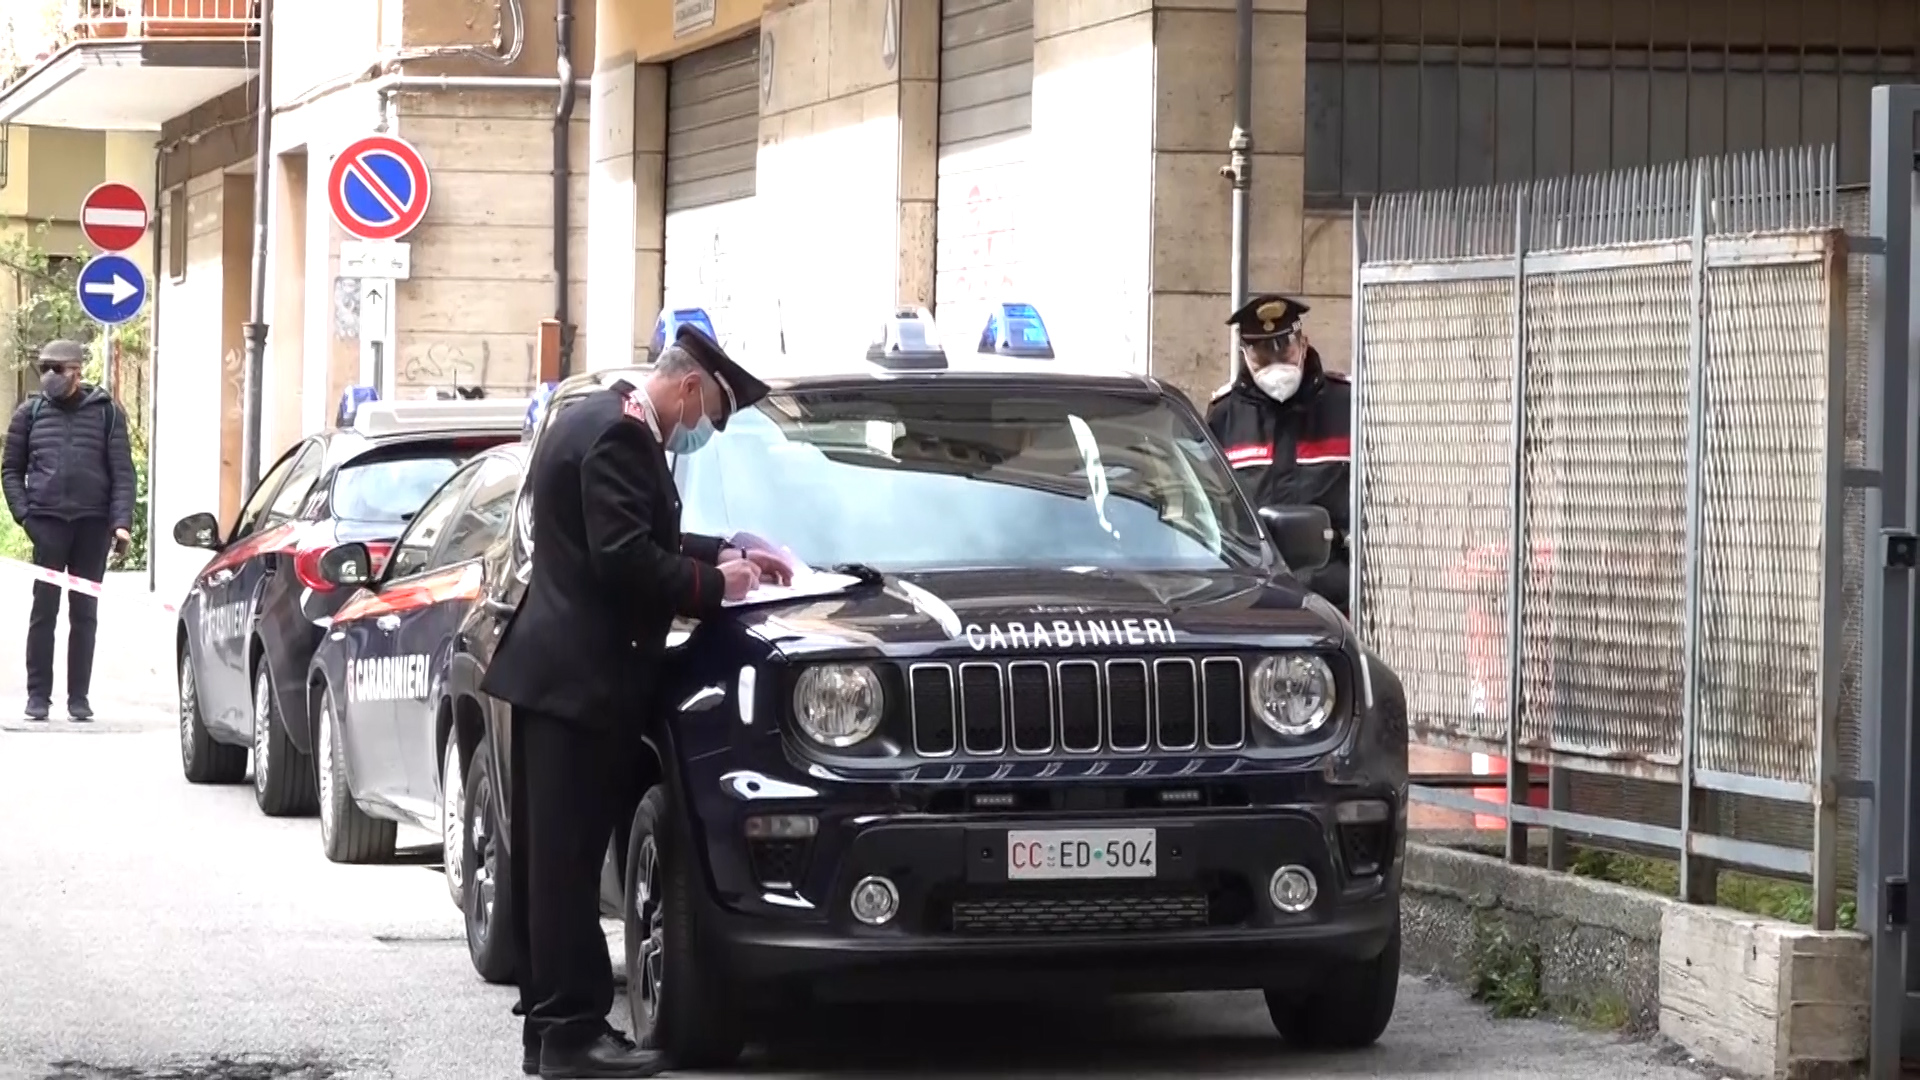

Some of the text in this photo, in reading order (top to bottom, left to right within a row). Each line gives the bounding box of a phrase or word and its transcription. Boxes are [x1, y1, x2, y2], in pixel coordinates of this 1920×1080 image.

[965, 617, 1176, 651] CARABINIERI
[356, 653, 430, 702] CARABINIERI
[1012, 840, 1153, 869] CC ED 504
